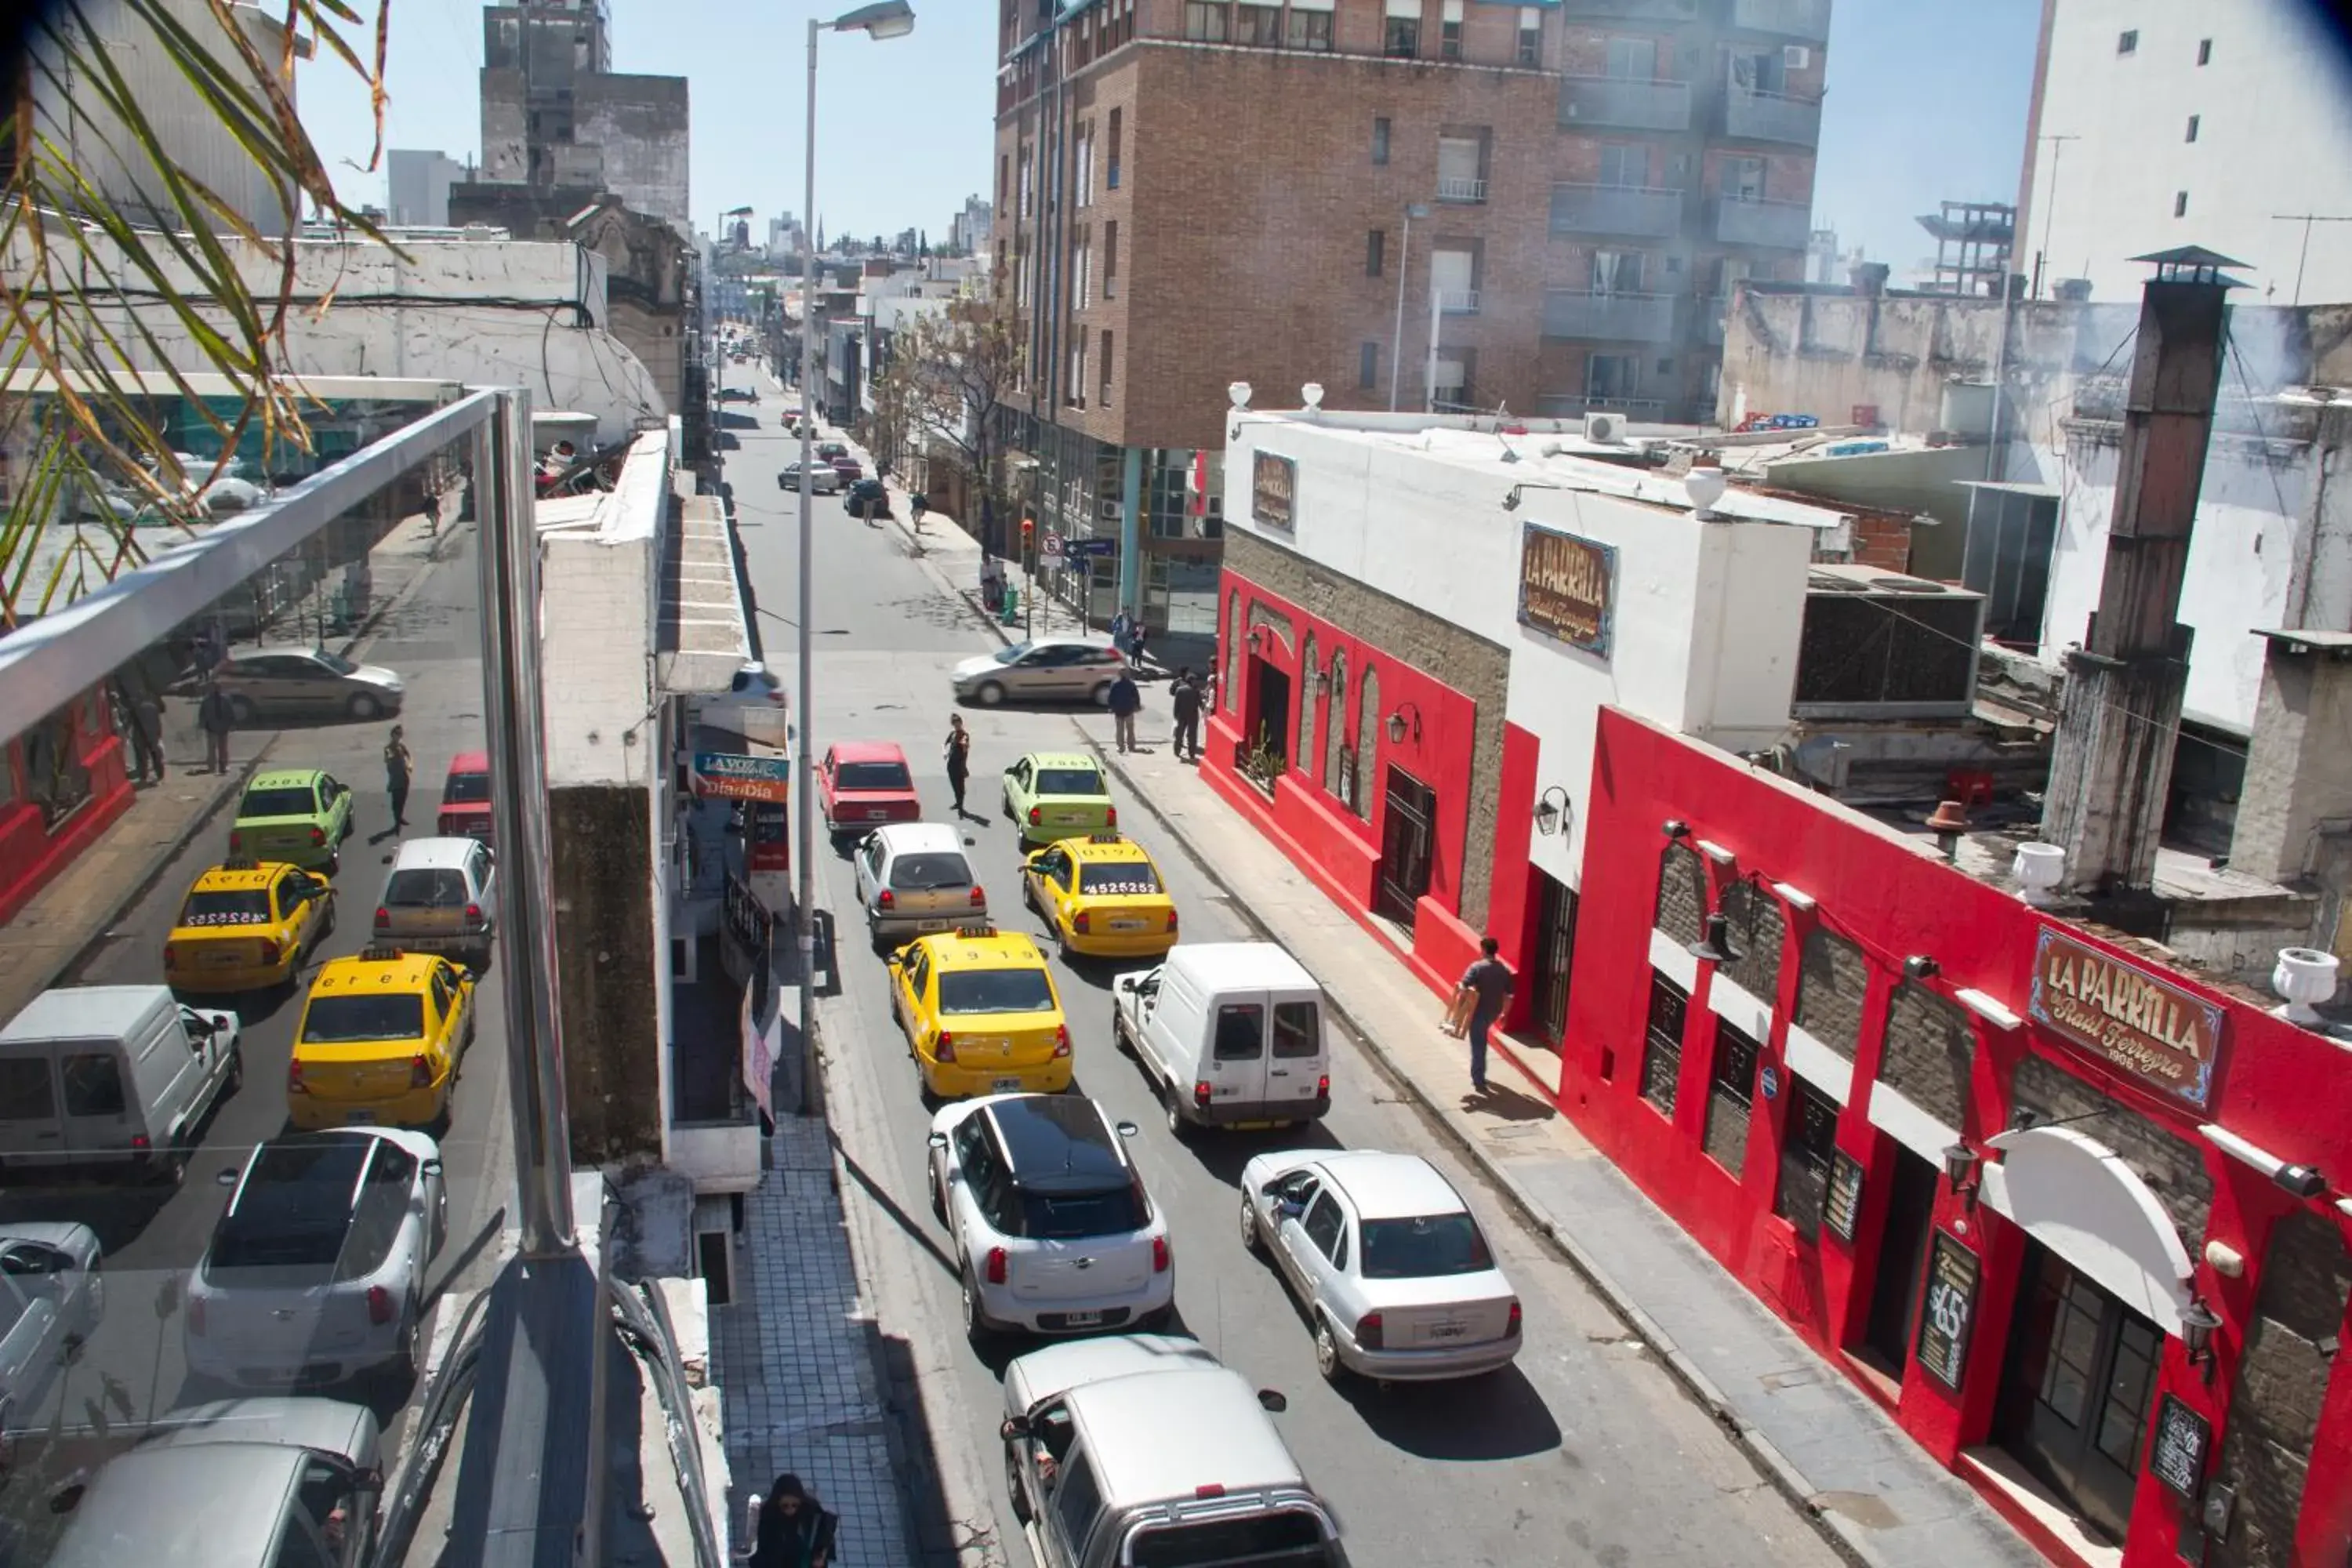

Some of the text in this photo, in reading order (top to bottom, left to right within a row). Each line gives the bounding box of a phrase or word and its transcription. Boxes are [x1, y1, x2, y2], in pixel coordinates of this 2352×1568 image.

[1526, 537, 1603, 608] LA PARRILLA
[704, 756, 725, 771] LA
[2049, 956, 2200, 1059] LA PARRILLA
